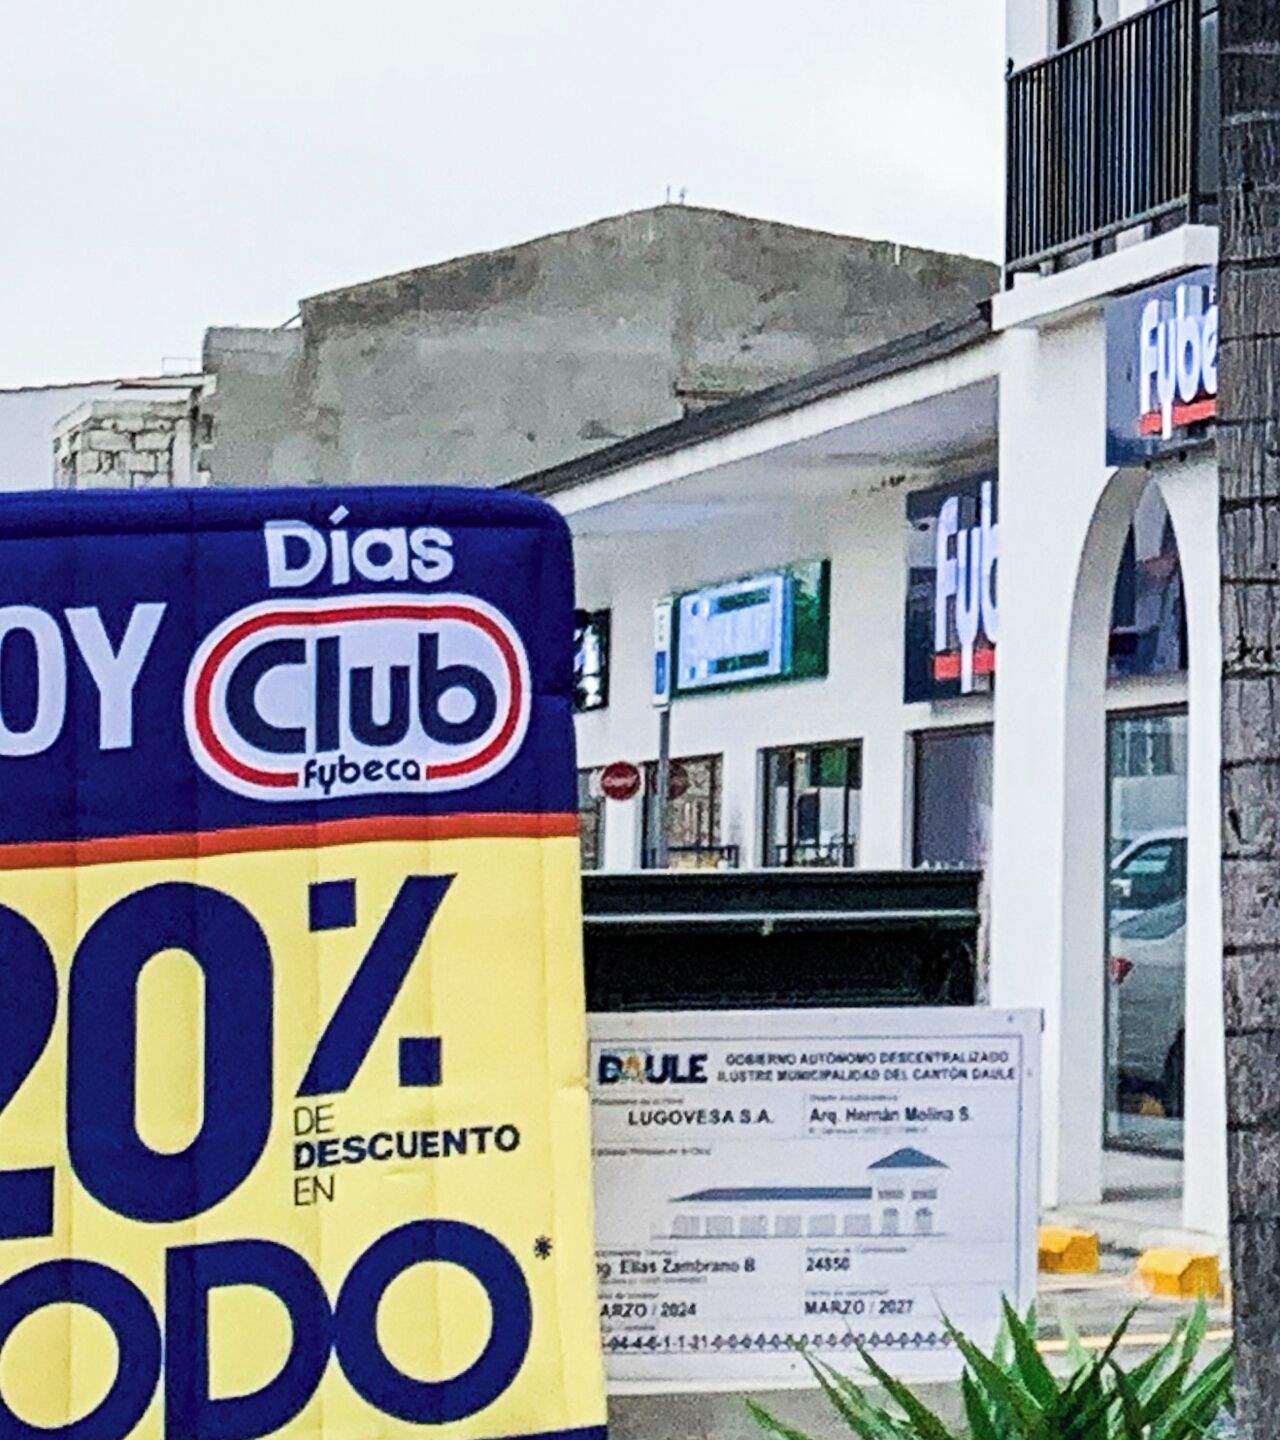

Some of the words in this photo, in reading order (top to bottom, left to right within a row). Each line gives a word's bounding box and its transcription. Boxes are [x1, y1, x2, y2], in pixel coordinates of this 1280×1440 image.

[264, 505, 454, 588] Días
[225, 632, 497, 755] Club
[303, 758, 420, 795] fybeca
[725, 1053, 796, 1066] GOBIERNO
[880, 1051, 1009, 1065] DESCENTRALIZADO
[717, 1070, 773, 1082] ILUSTRE
[777, 1068, 881, 1082] MUNICIPALIDAD
[884, 1068, 908, 1081] DEL
[972, 1068, 1015, 1081] DAULE
[294, 1102, 335, 1135] DE
[628, 1109, 734, 1126] LUGOVESA
[904, 1106, 954, 1123] Molina
[294, 1124, 520, 1171] DESCUENTO
[294, 1174, 335, 1206] EN
[661, 1301, 697, 1318] 2024
[804, 1300, 866, 1316] MARZO
